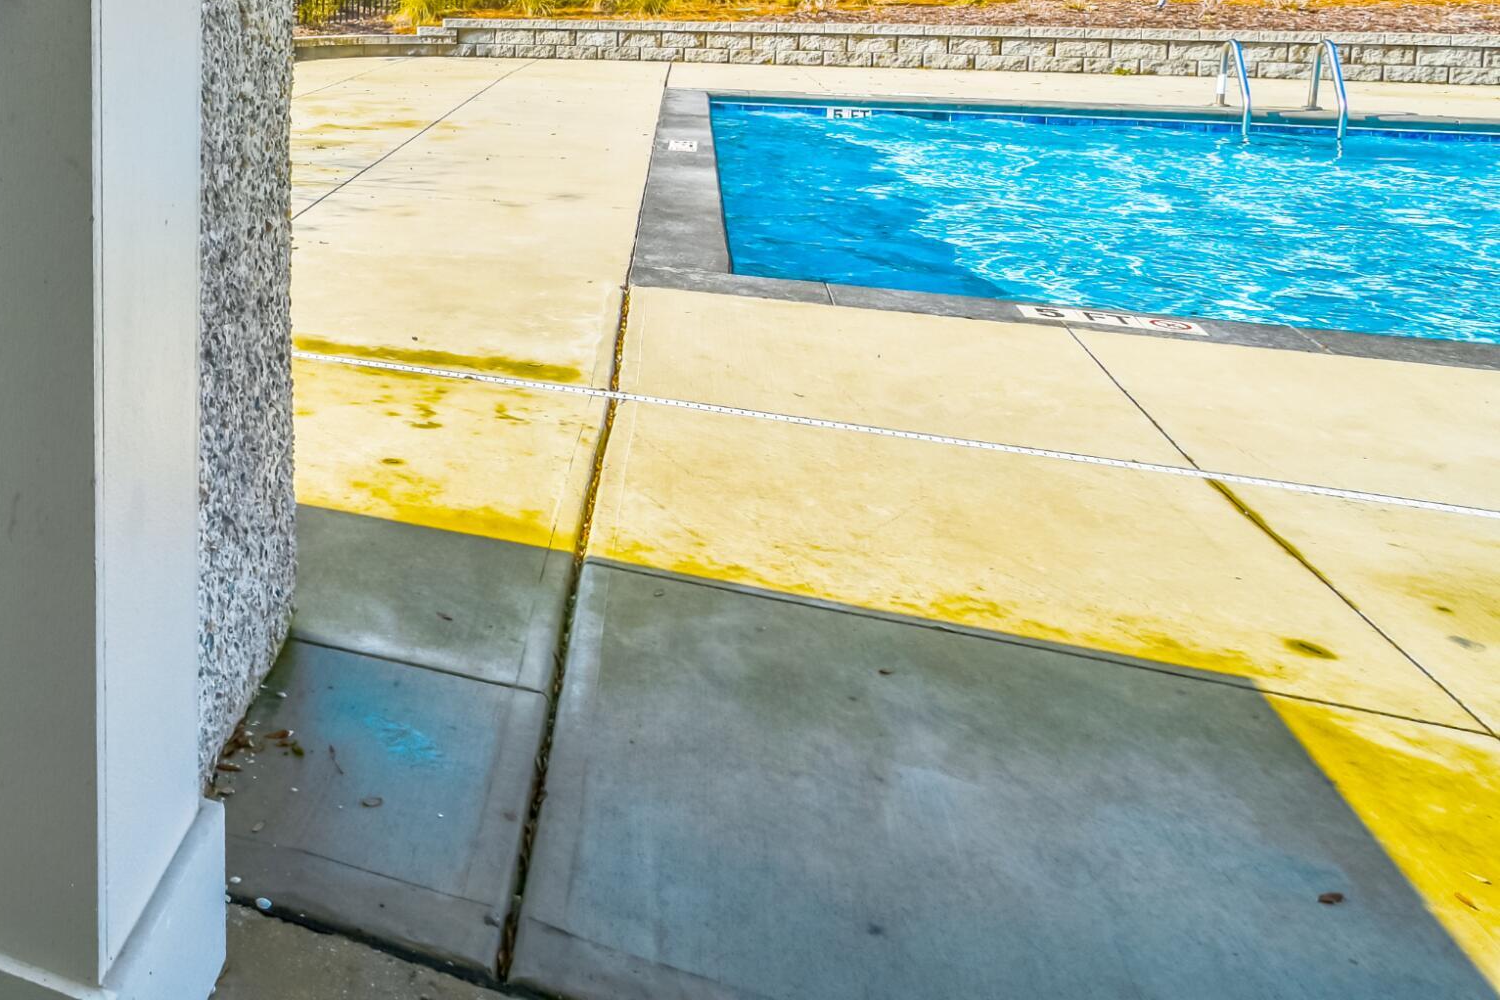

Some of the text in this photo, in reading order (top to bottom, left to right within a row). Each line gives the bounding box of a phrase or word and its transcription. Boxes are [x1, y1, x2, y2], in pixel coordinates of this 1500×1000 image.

[851, 109, 870, 118] FT
[1035, 308, 1129, 325] 5 FT
